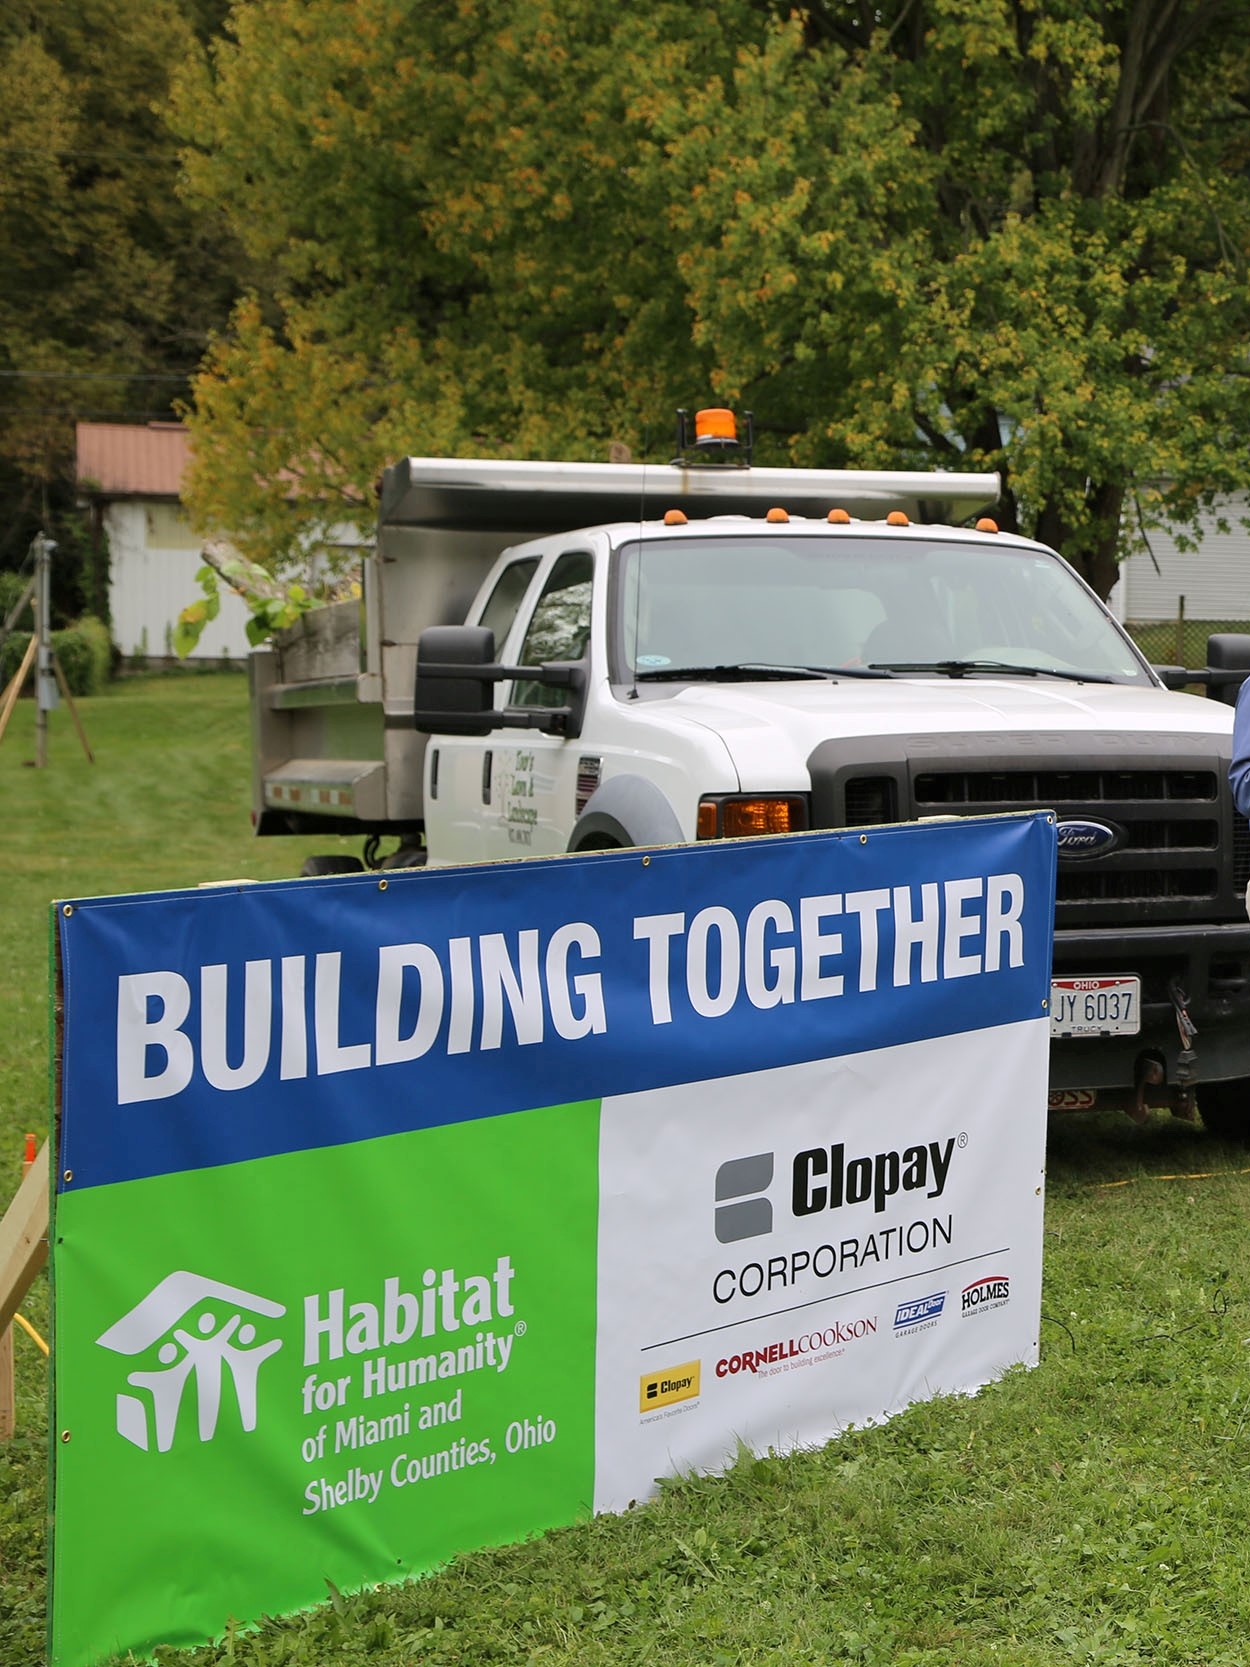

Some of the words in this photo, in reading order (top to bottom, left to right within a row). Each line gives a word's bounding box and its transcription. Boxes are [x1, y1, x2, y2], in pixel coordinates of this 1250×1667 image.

[906, 733, 1068, 749] SUPER
[1094, 733, 1208, 748] DUTY
[1057, 826, 1097, 846] Ford
[117, 921, 607, 1105] BUILDING
[633, 873, 1025, 1025] TOGETHER
[1073, 981, 1100, 990] OHIO
[1085, 992, 1133, 1021] 6037
[1048, 1090, 1093, 1107] OSS
[713, 1214, 953, 1304] CORPORATION
[961, 1281, 1010, 1311] HOLMES
[303, 1255, 515, 1367] Habitat
[961, 1309, 978, 1318] GARAGE
[978, 1306, 990, 1314] DOOR
[895, 1327, 919, 1338] GARAGE
[919, 1320, 938, 1334] DOORS
[758, 1369, 768, 1379] The
[769, 1366, 783, 1377] door
[783, 1363, 790, 1372] to
[790, 1355, 813, 1369] building
[302, 1373, 351, 1415] for
[660, 1376, 693, 1394] Clopay
[301, 1424, 328, 1463] of
[335, 1402, 411, 1453] Miami
[417, 1388, 463, 1430] and
[302, 1467, 384, 1516] Shelby
[390, 1437, 497, 1488] Counties,
[504, 1415, 557, 1453] Ohio
